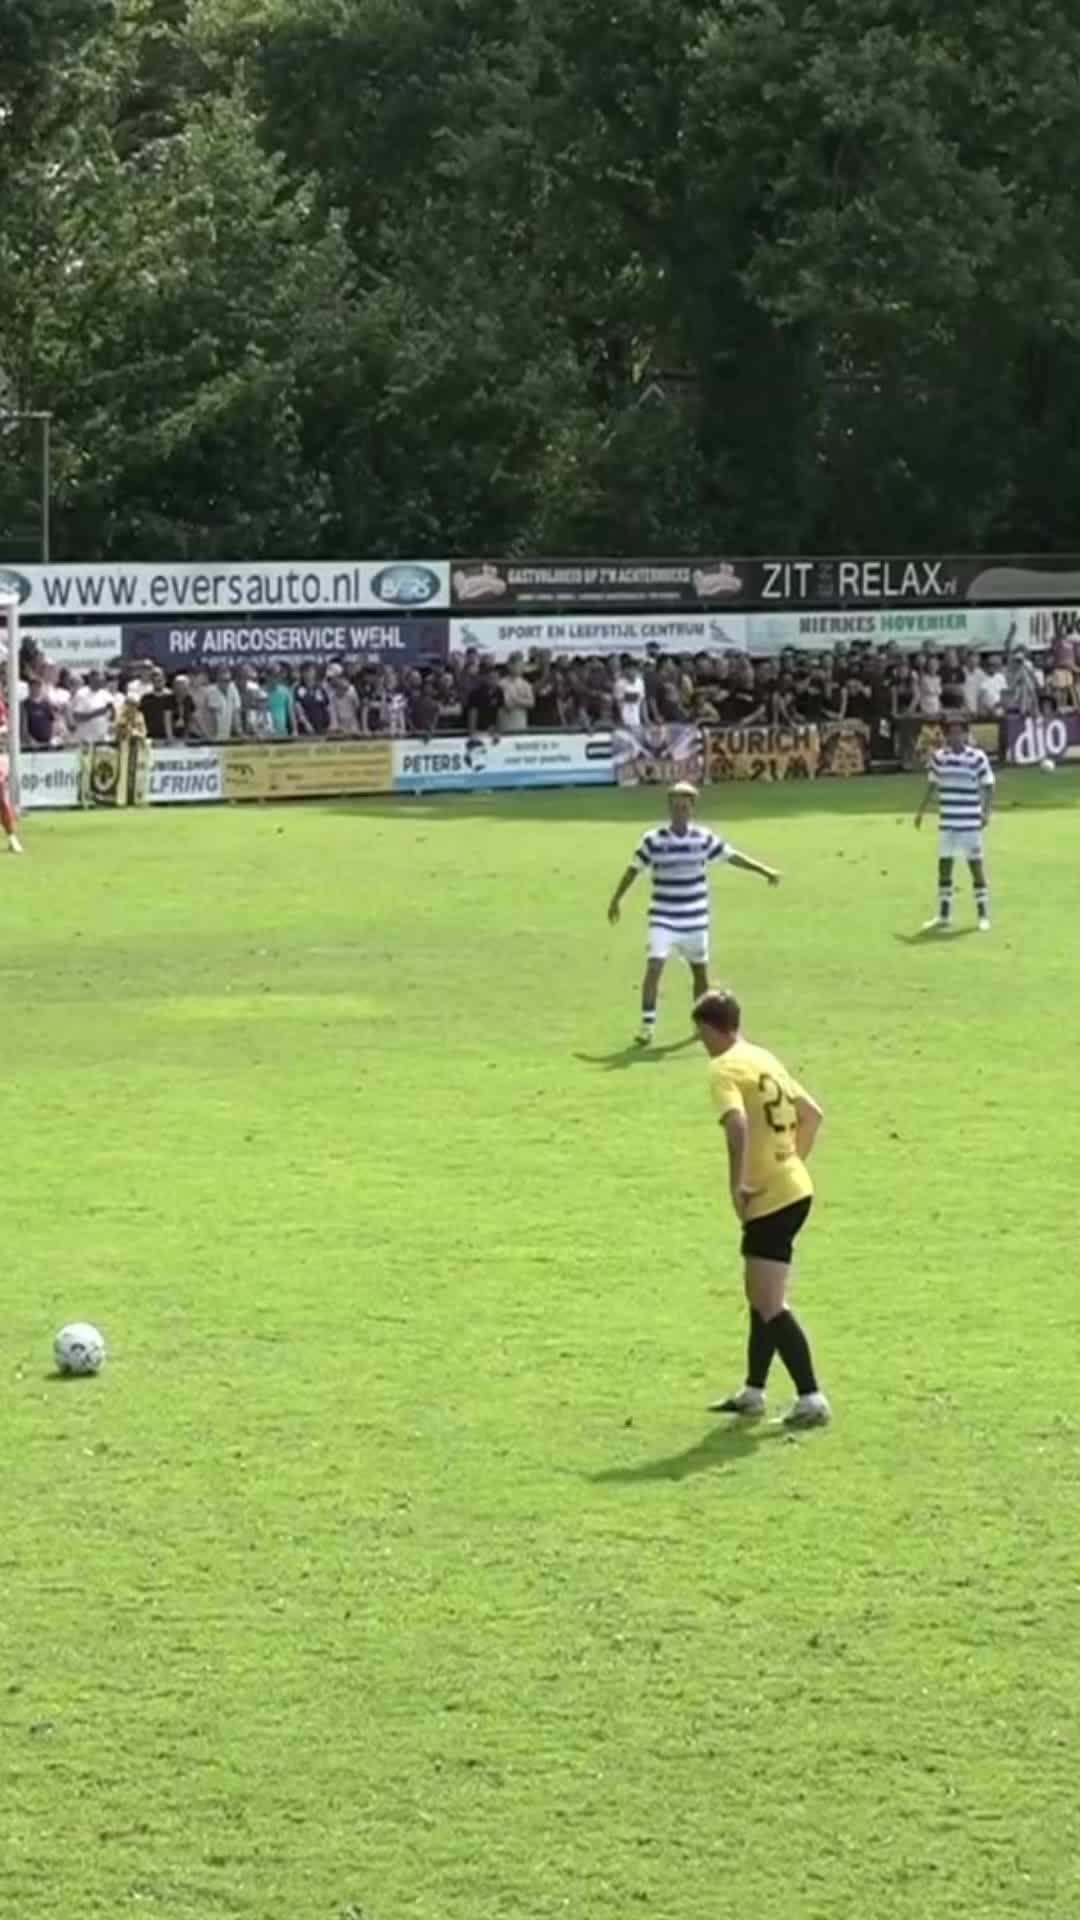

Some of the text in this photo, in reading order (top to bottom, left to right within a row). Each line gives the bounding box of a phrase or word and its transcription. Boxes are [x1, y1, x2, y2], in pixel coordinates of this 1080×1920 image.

[42, 568, 360, 606] www.eversauto.nl
[761, 563, 814, 598] ZIT
[169, 625, 405, 653] RK AIRCOSERVICE WEHL
[498, 625, 541, 640] SPORT
[547, 625, 565, 639] EN
[641, 622, 705, 638] CENTRUM
[1015, 716, 1067, 764] dio
[402, 755, 462, 774] PETERS
[149, 774, 218, 793] LFRING
